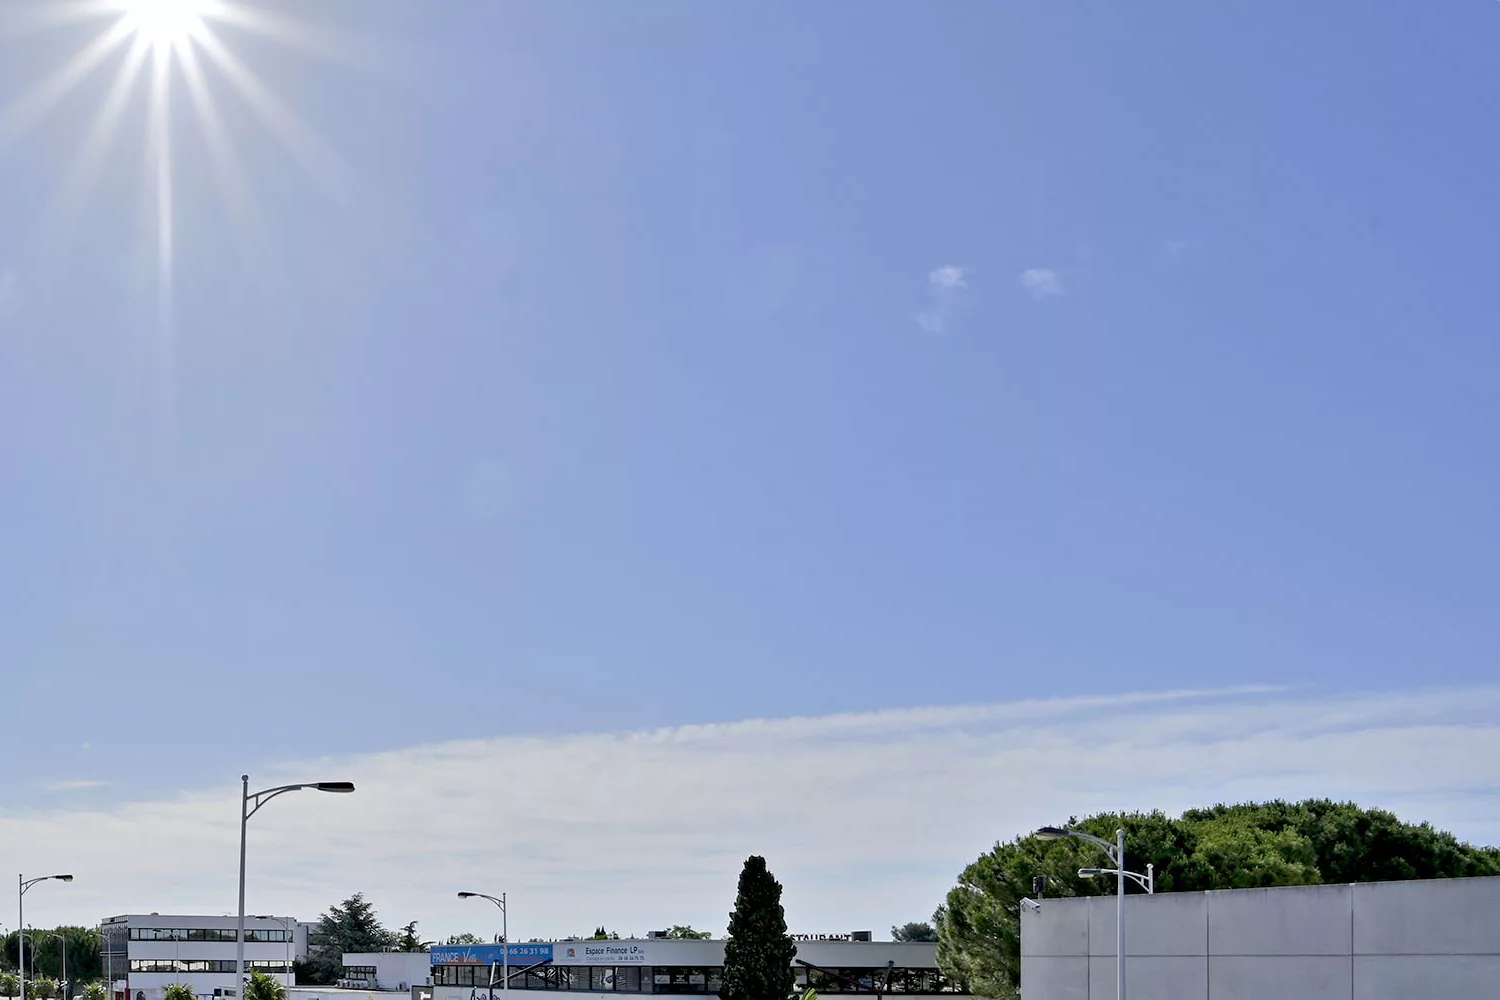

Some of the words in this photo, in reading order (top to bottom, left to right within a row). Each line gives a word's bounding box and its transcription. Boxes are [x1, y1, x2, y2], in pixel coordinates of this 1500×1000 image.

[432, 952, 459, 963] FRANCE
[540, 947, 549, 955] 98
[585, 947, 604, 956] Espace
[606, 946, 628, 955] Finance
[630, 946, 638, 954] LP
